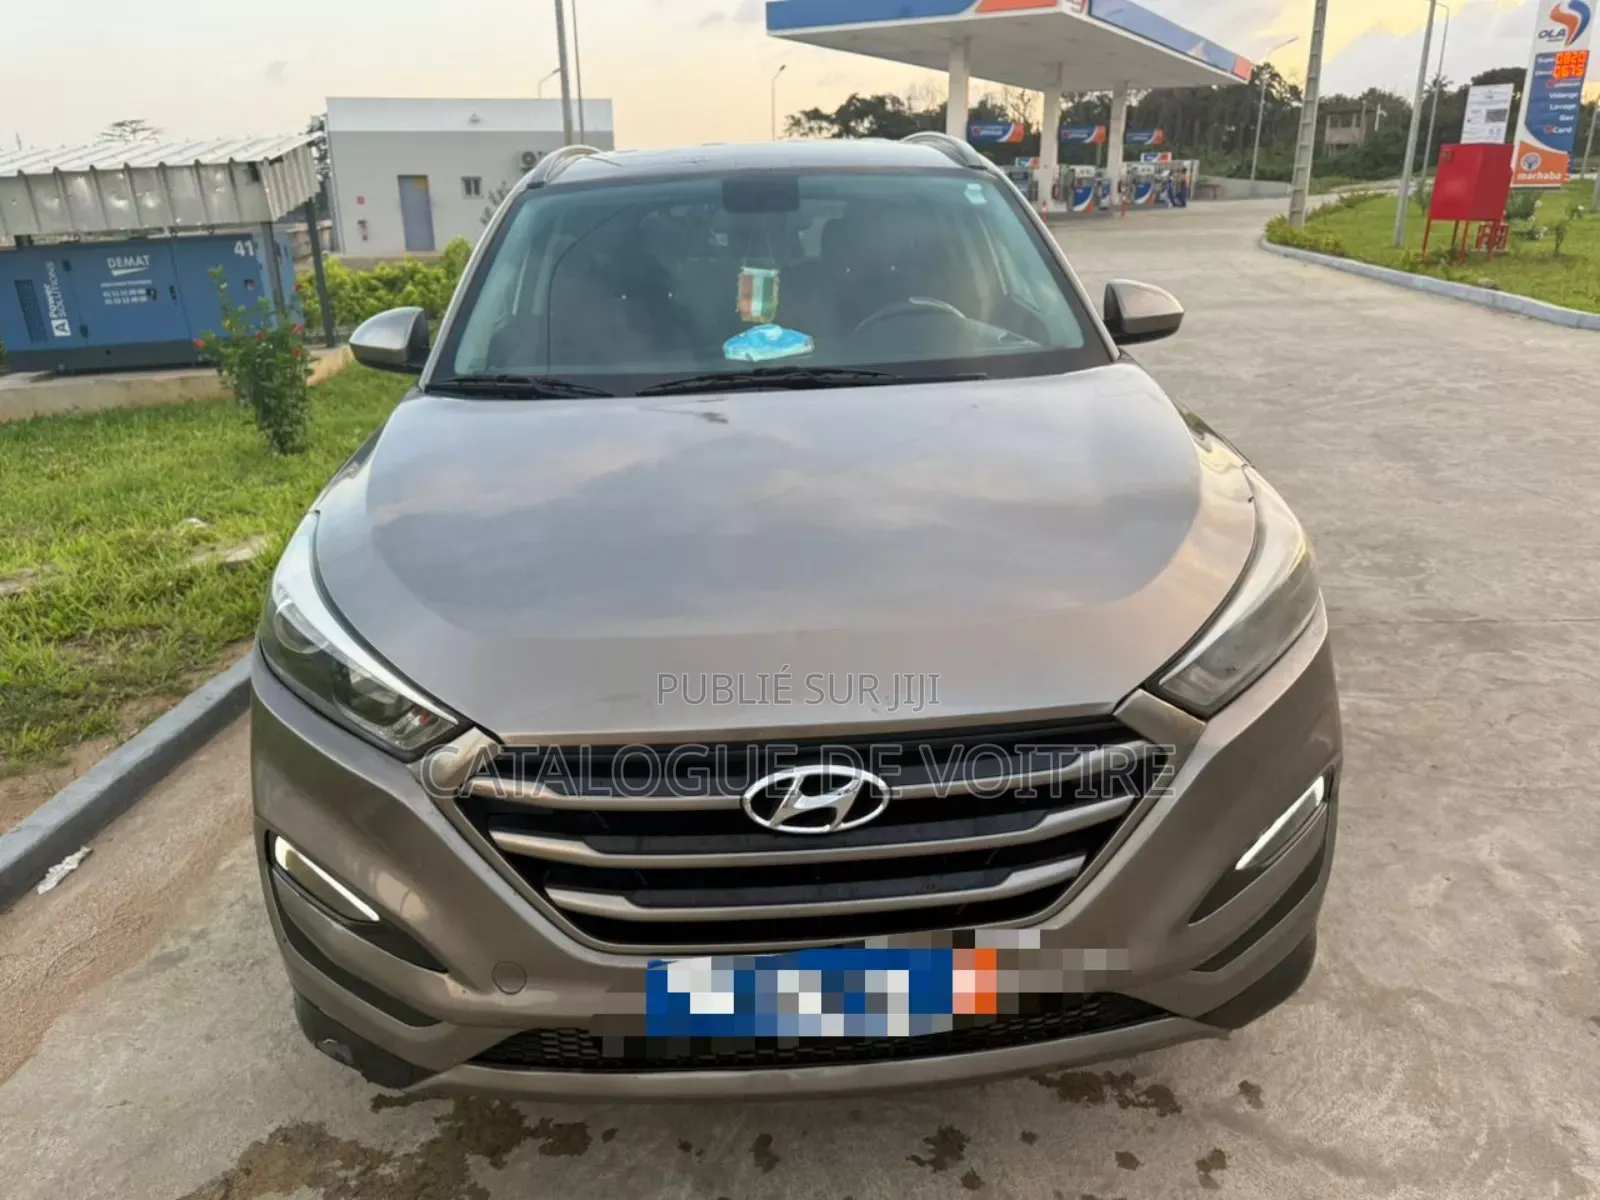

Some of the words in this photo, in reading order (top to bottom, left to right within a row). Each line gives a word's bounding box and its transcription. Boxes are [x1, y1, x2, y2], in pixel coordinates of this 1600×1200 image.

[1538, 28, 1566, 39] OLA
[1517, 171, 1562, 180] marhaba
[234, 240, 254, 257] 41
[107, 255, 150, 269] DEMAT
